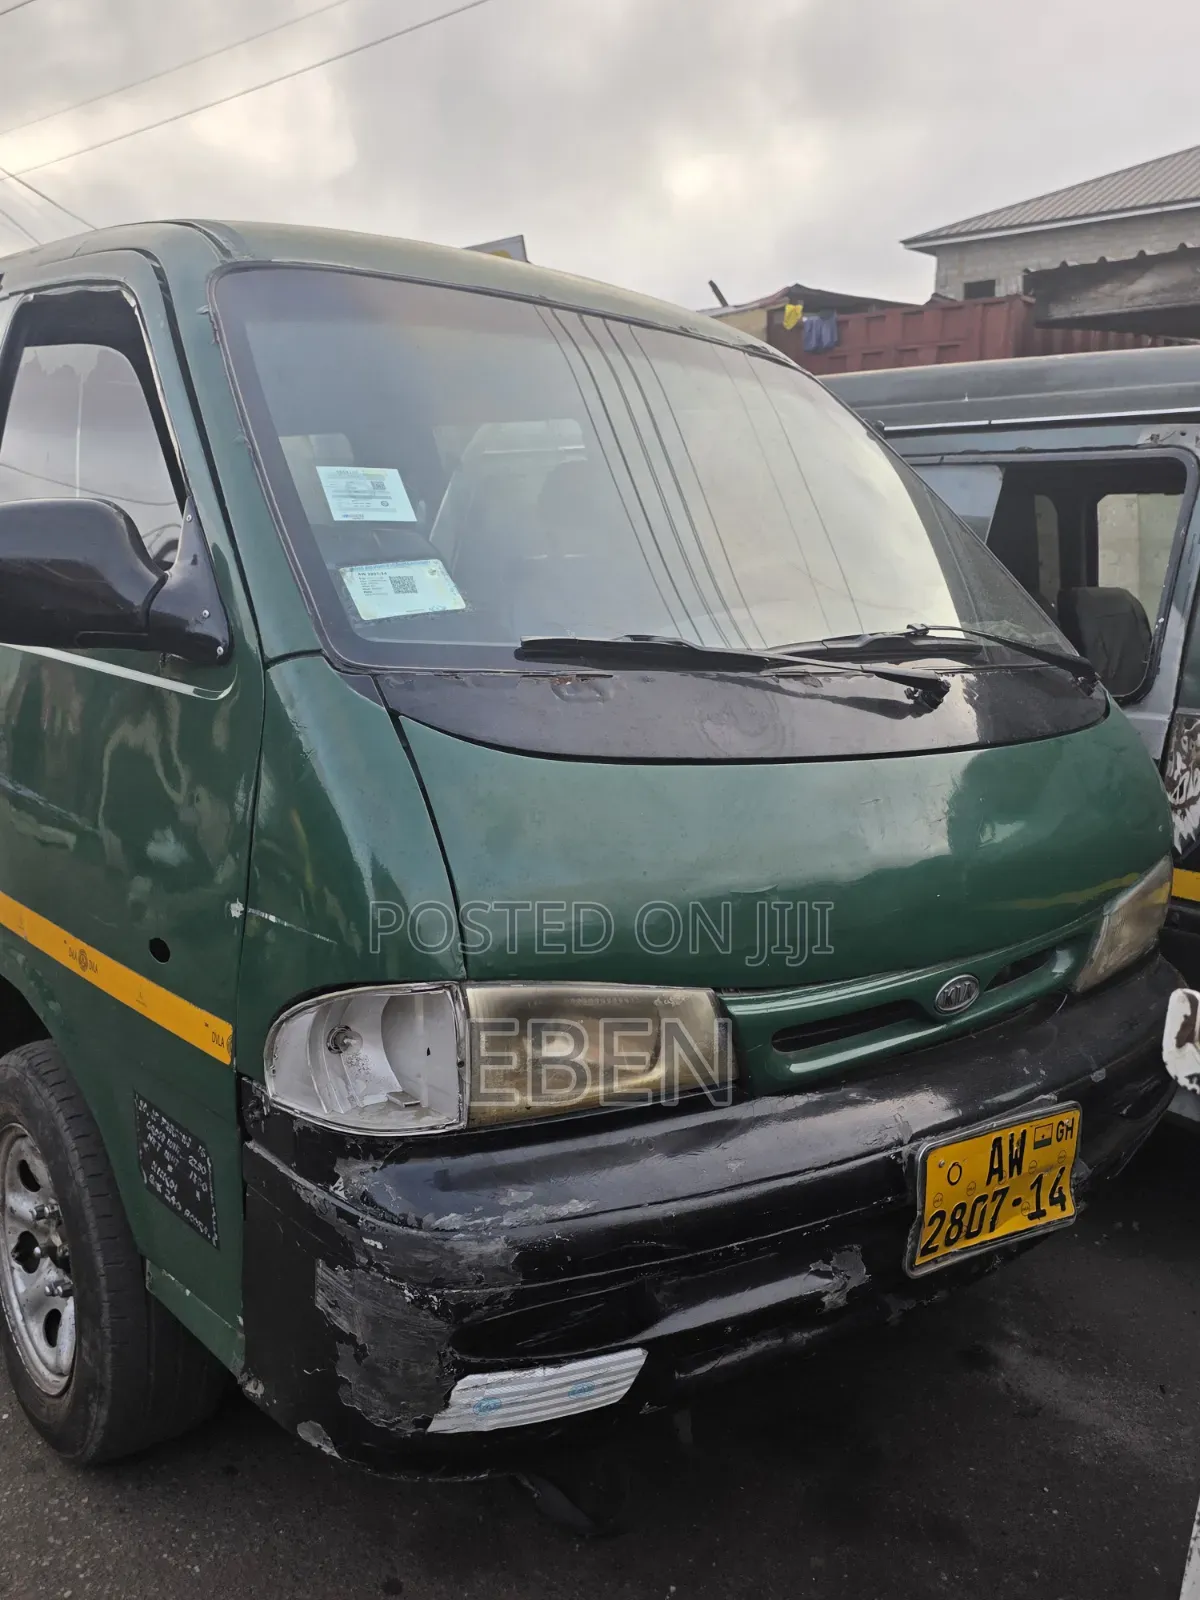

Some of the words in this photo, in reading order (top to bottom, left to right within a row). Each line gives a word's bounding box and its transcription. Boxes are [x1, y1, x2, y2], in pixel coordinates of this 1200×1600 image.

[211, 1031, 225, 1048] DVLA
[1055, 1117, 1075, 1143] GH
[985, 1129, 1027, 1186] AW
